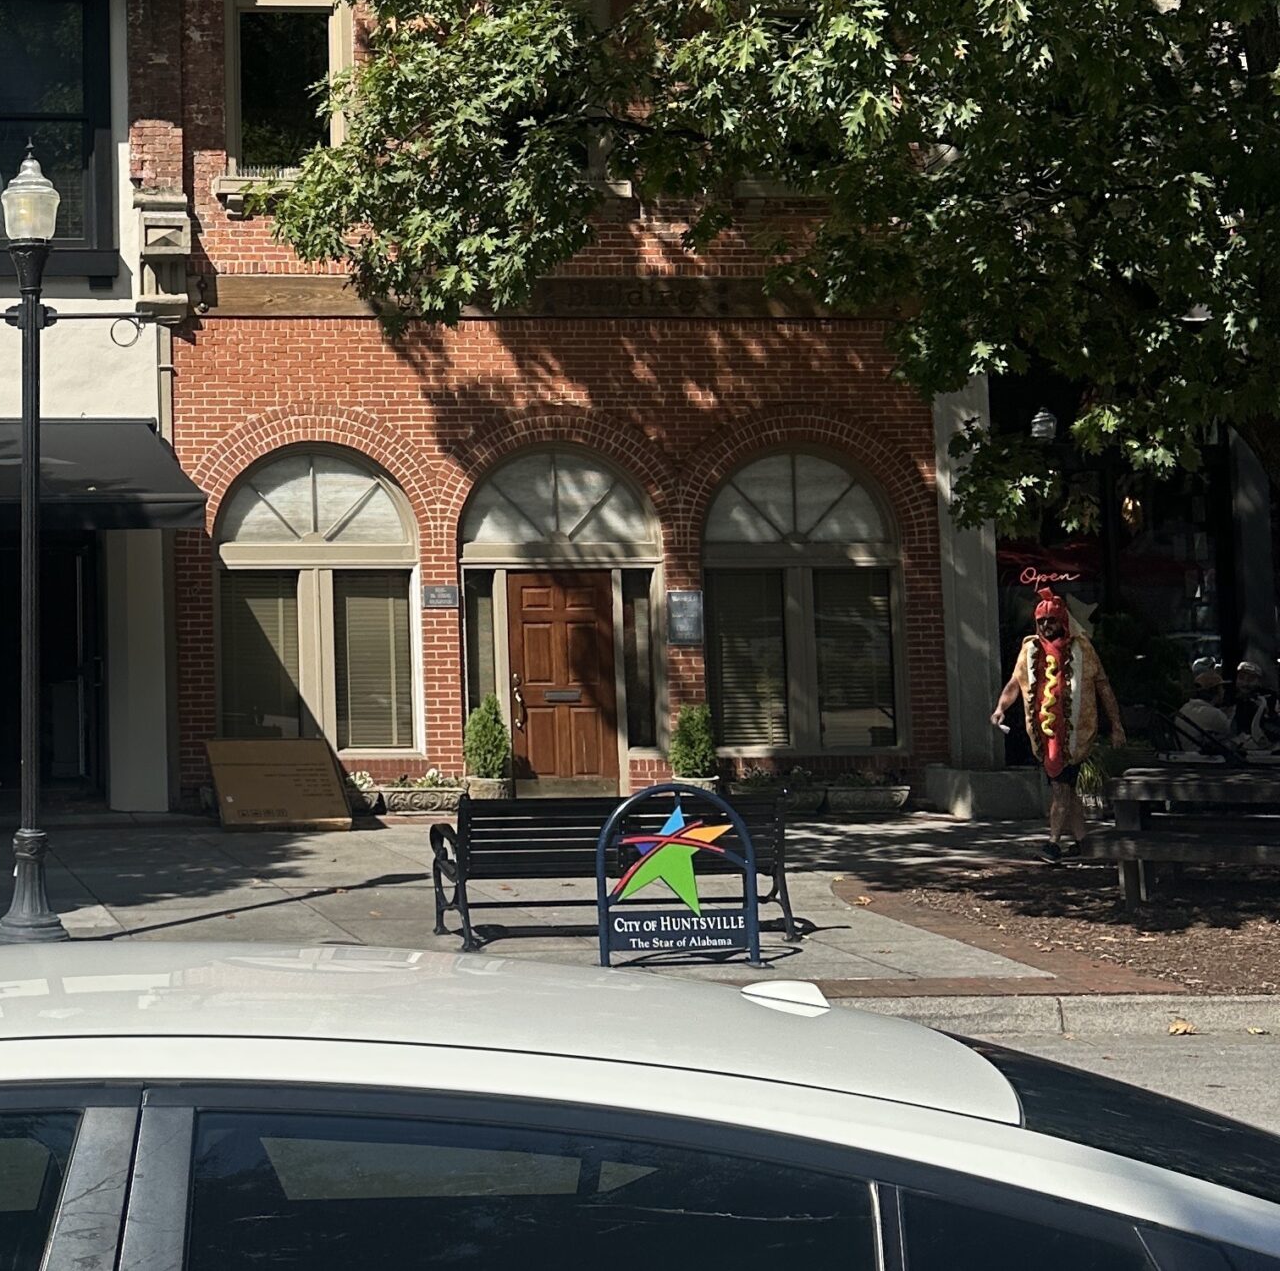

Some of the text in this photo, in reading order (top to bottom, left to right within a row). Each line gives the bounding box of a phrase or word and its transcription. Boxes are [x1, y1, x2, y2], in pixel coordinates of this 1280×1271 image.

[568, 282, 697, 313] Building
[1020, 567, 1080, 592] Open
[660, 916, 745, 931] HUNTSVILLE
[630, 935, 733, 949] The Star of Alabama
